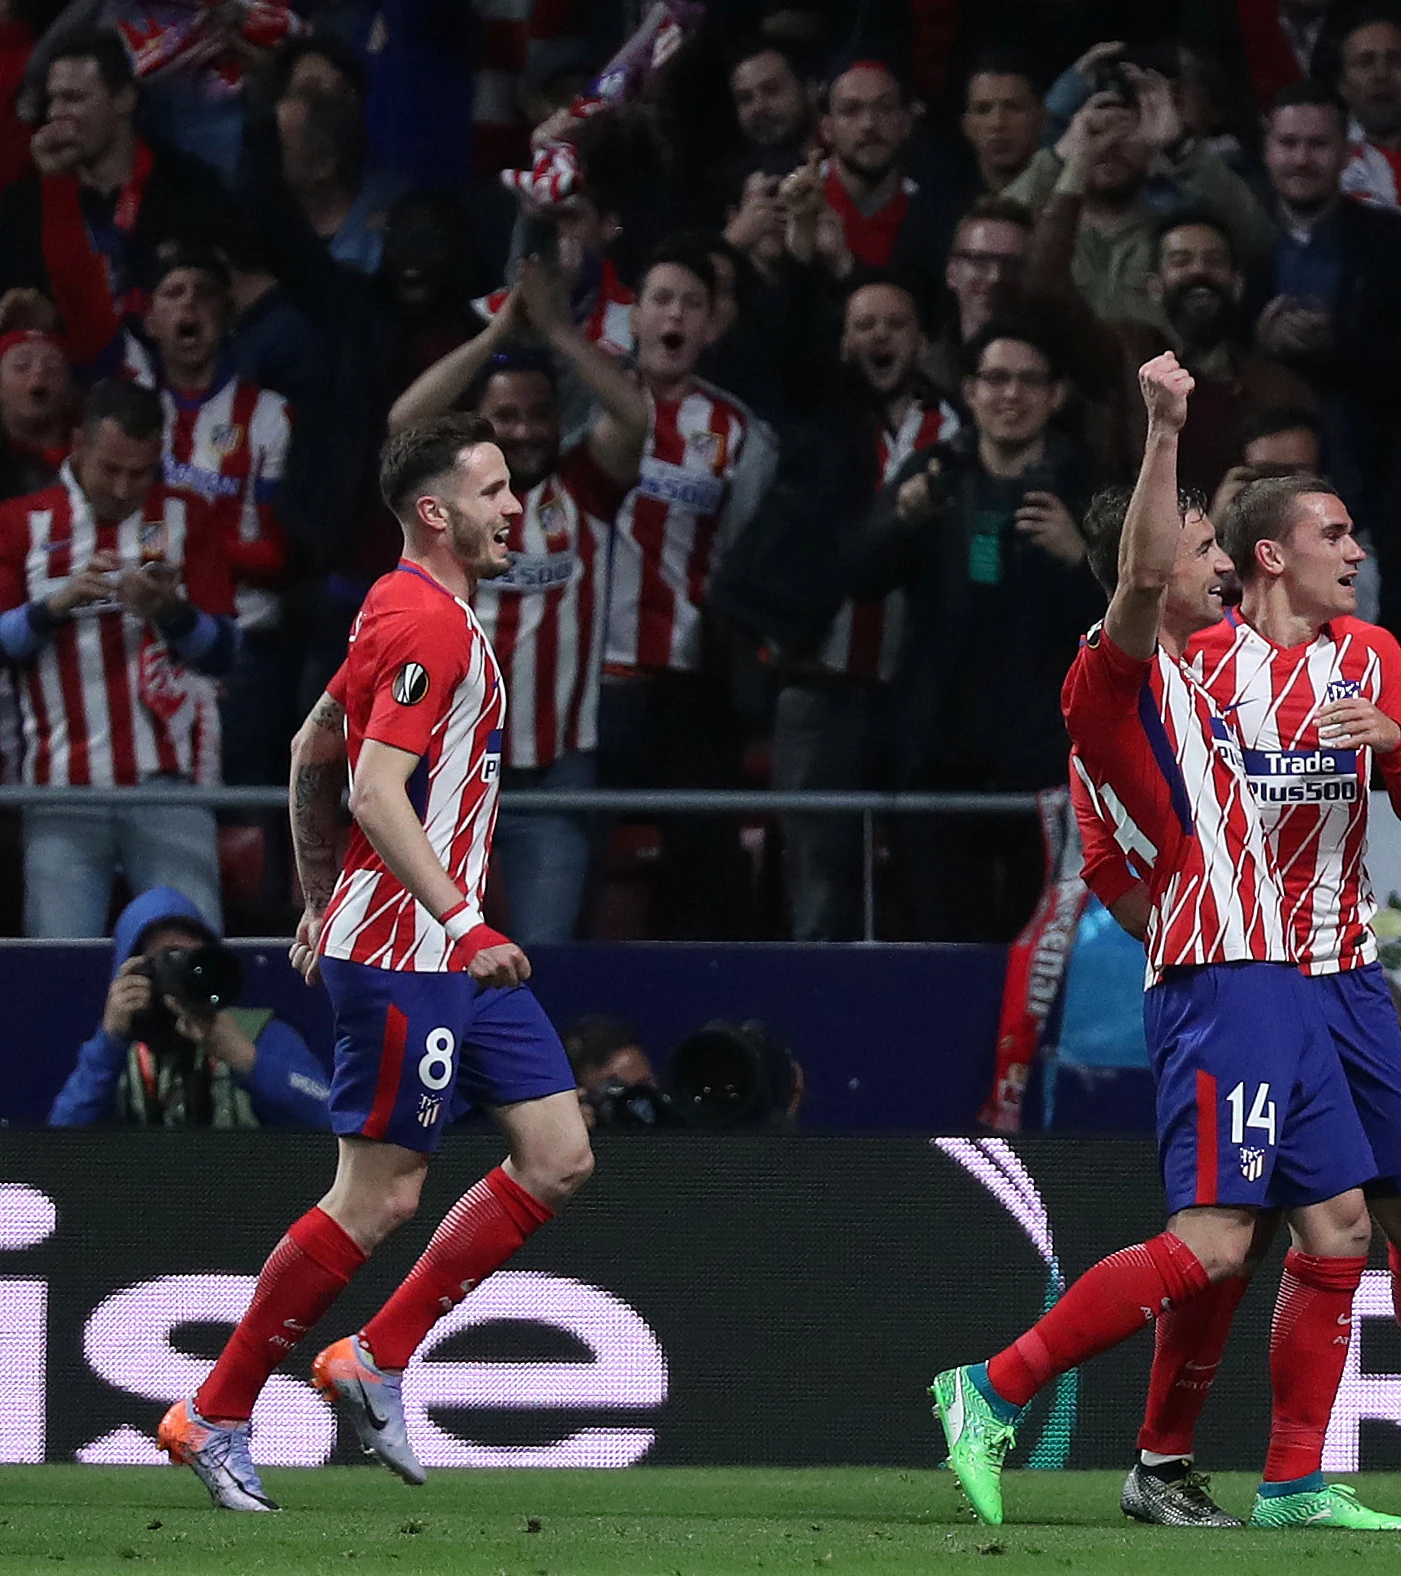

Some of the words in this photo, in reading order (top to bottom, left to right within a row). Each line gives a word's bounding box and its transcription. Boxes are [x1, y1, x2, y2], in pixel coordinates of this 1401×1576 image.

[1264, 751, 1335, 774] Trade
[417, 1026, 455, 1092] 8
[1226, 1081, 1276, 1146] 14
